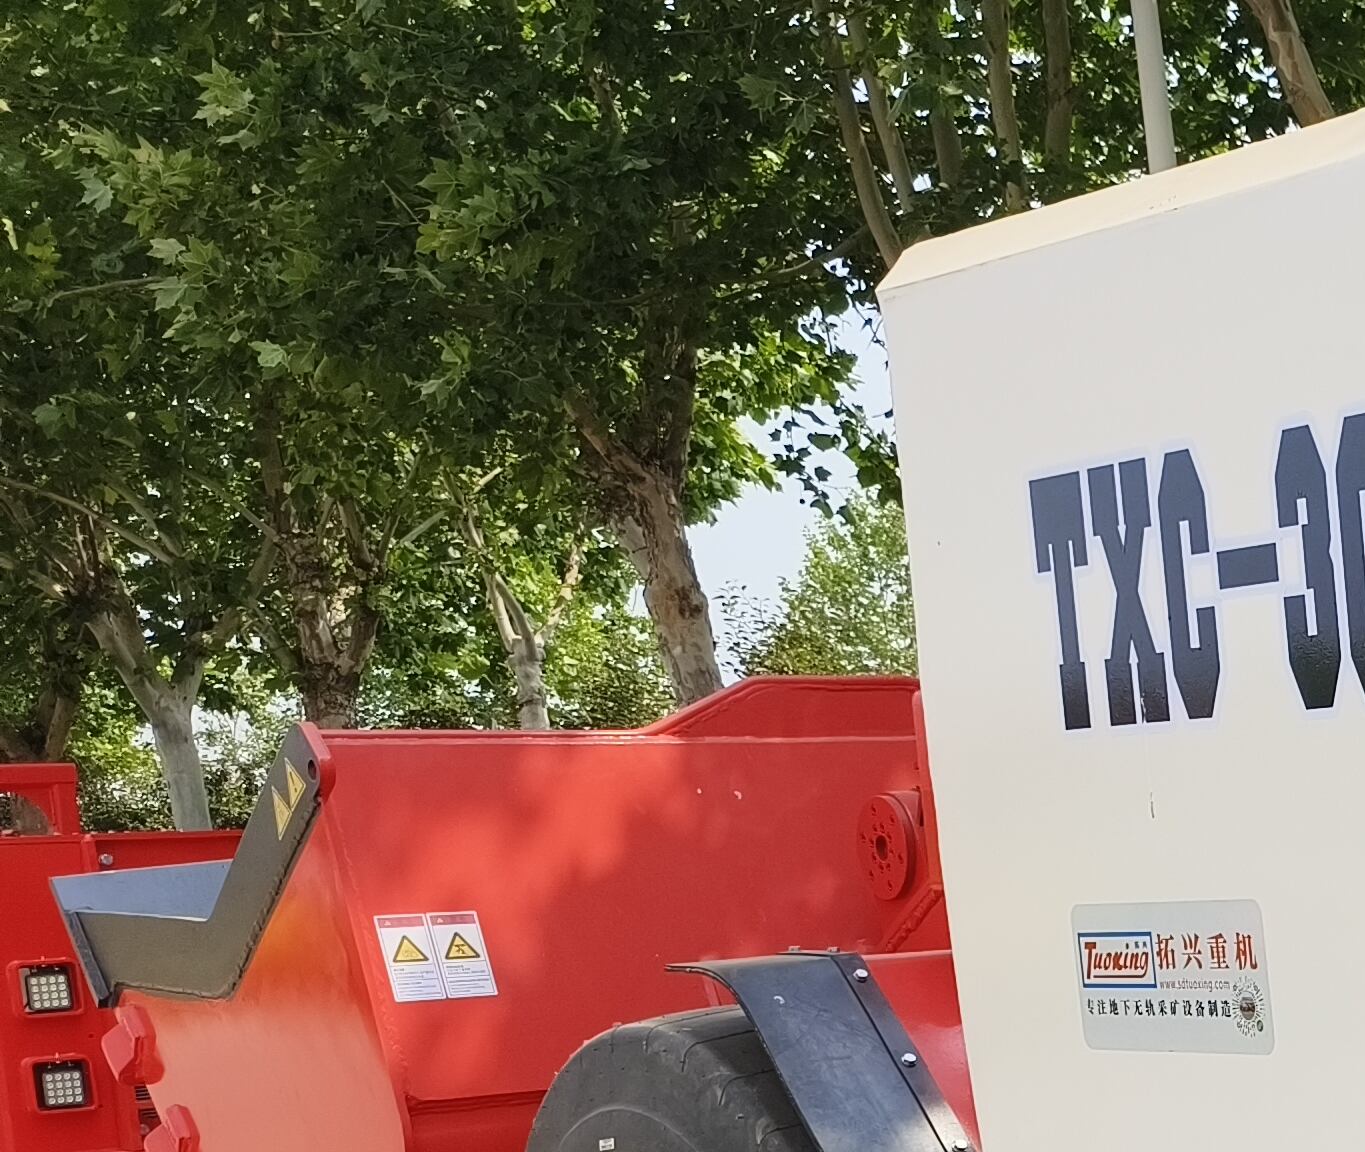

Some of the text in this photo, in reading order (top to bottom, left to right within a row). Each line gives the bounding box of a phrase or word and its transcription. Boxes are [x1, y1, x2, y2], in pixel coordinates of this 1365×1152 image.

[1084, 942, 1149, 979] Tuoxing
[1155, 932, 1258, 970] 拓兴重机
[1160, 978, 1231, 992] www.sdtuoxing.com
[1087, 998, 1232, 1018] 专注地下无轨采矿设备制造
